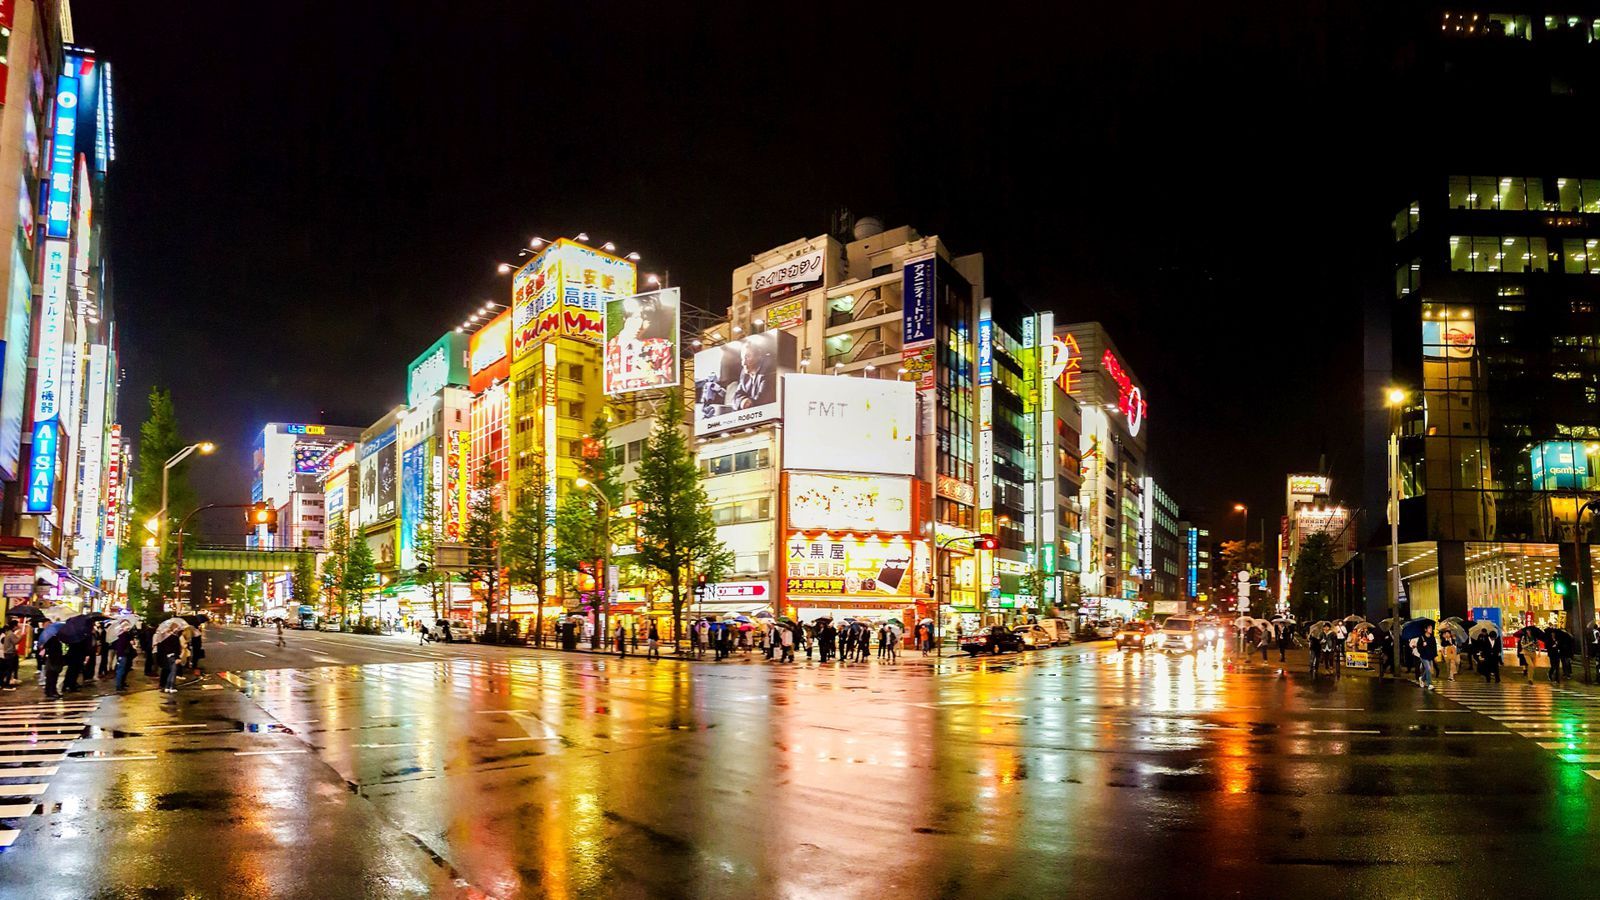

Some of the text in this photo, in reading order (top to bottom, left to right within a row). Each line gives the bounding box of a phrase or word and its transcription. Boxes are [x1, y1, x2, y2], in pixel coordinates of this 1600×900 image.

[755, 256, 821, 289] メイドカジノ
[913, 263, 925, 338] アメニティードリーム
[32, 424, 52, 503] AISAN
[790, 544, 845, 560] 大黒屋
